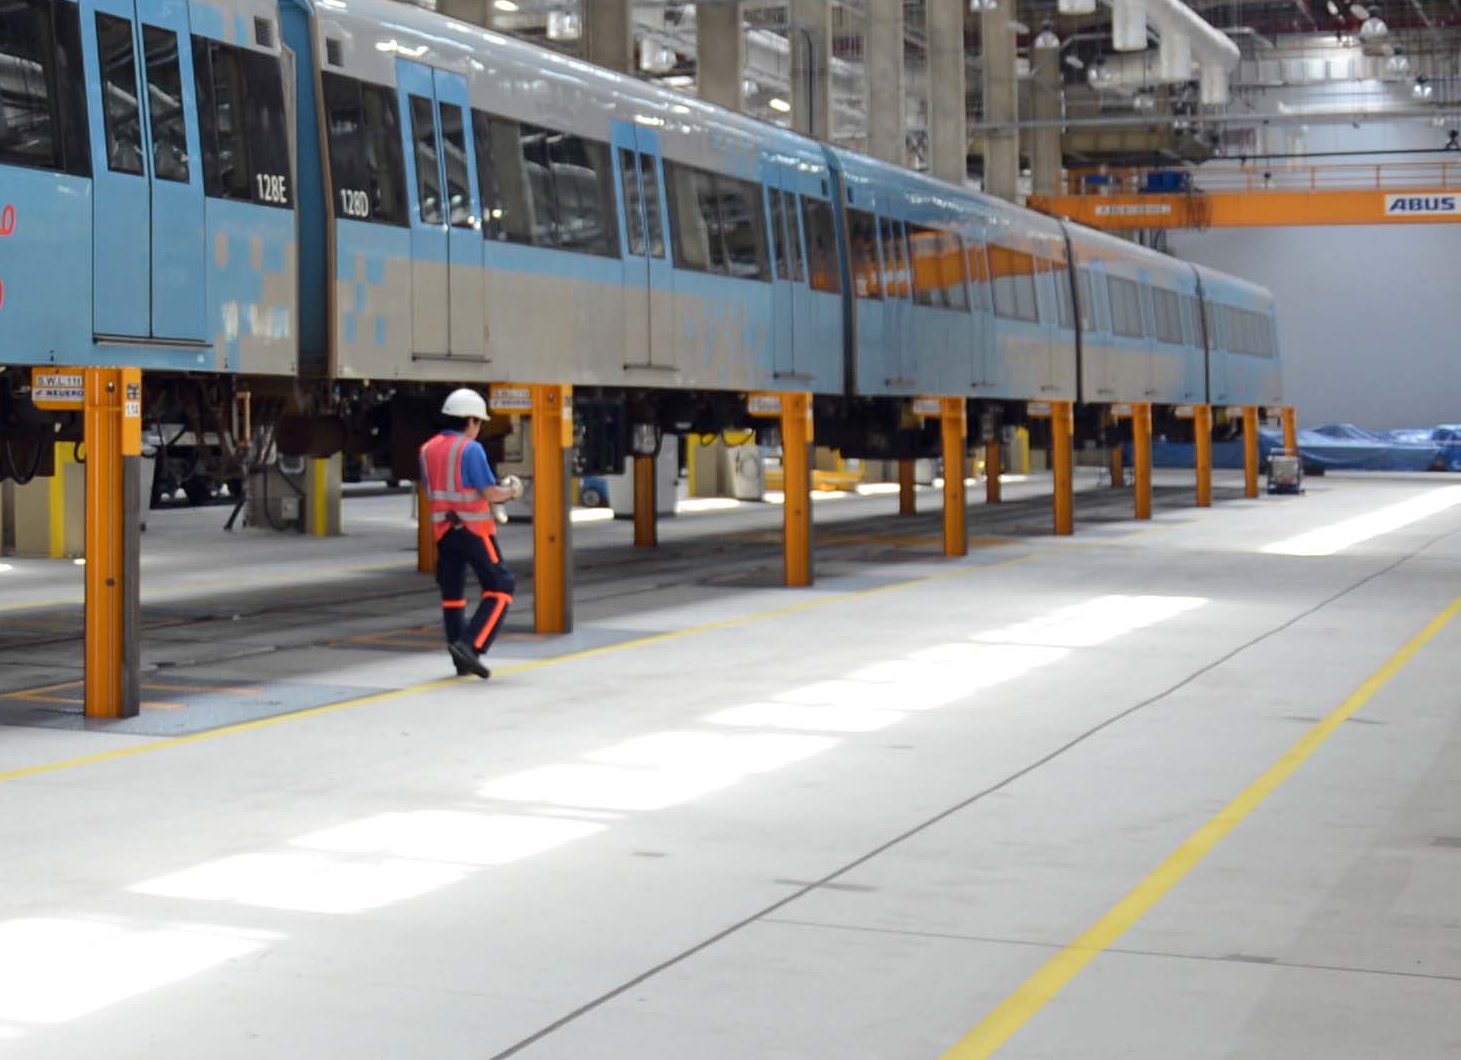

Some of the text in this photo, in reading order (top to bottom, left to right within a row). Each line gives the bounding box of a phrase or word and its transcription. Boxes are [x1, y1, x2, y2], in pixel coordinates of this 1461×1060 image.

[256, 173, 287, 203] 128E
[340, 189, 369, 217] 128D
[1389, 197, 1455, 212] ABUS
